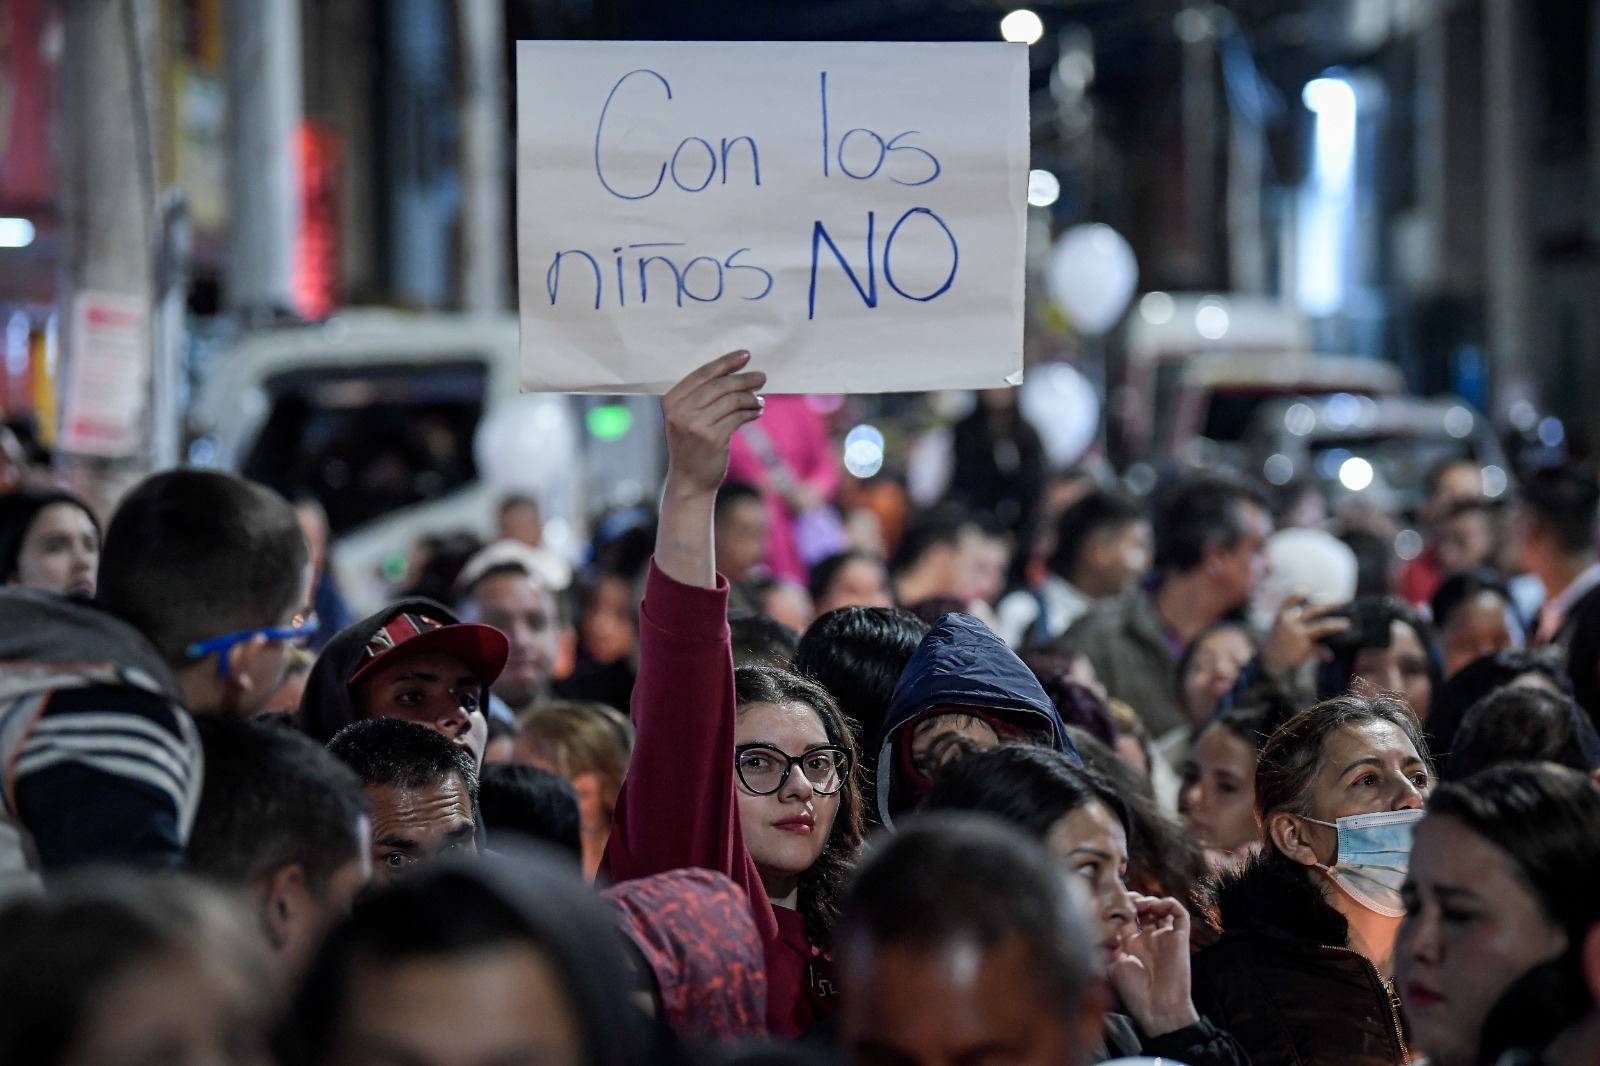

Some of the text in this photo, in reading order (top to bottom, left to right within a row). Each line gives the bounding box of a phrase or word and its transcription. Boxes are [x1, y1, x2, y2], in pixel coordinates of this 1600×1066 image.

[595, 69, 941, 200] Con los
[547, 207, 959, 320] niños NO
